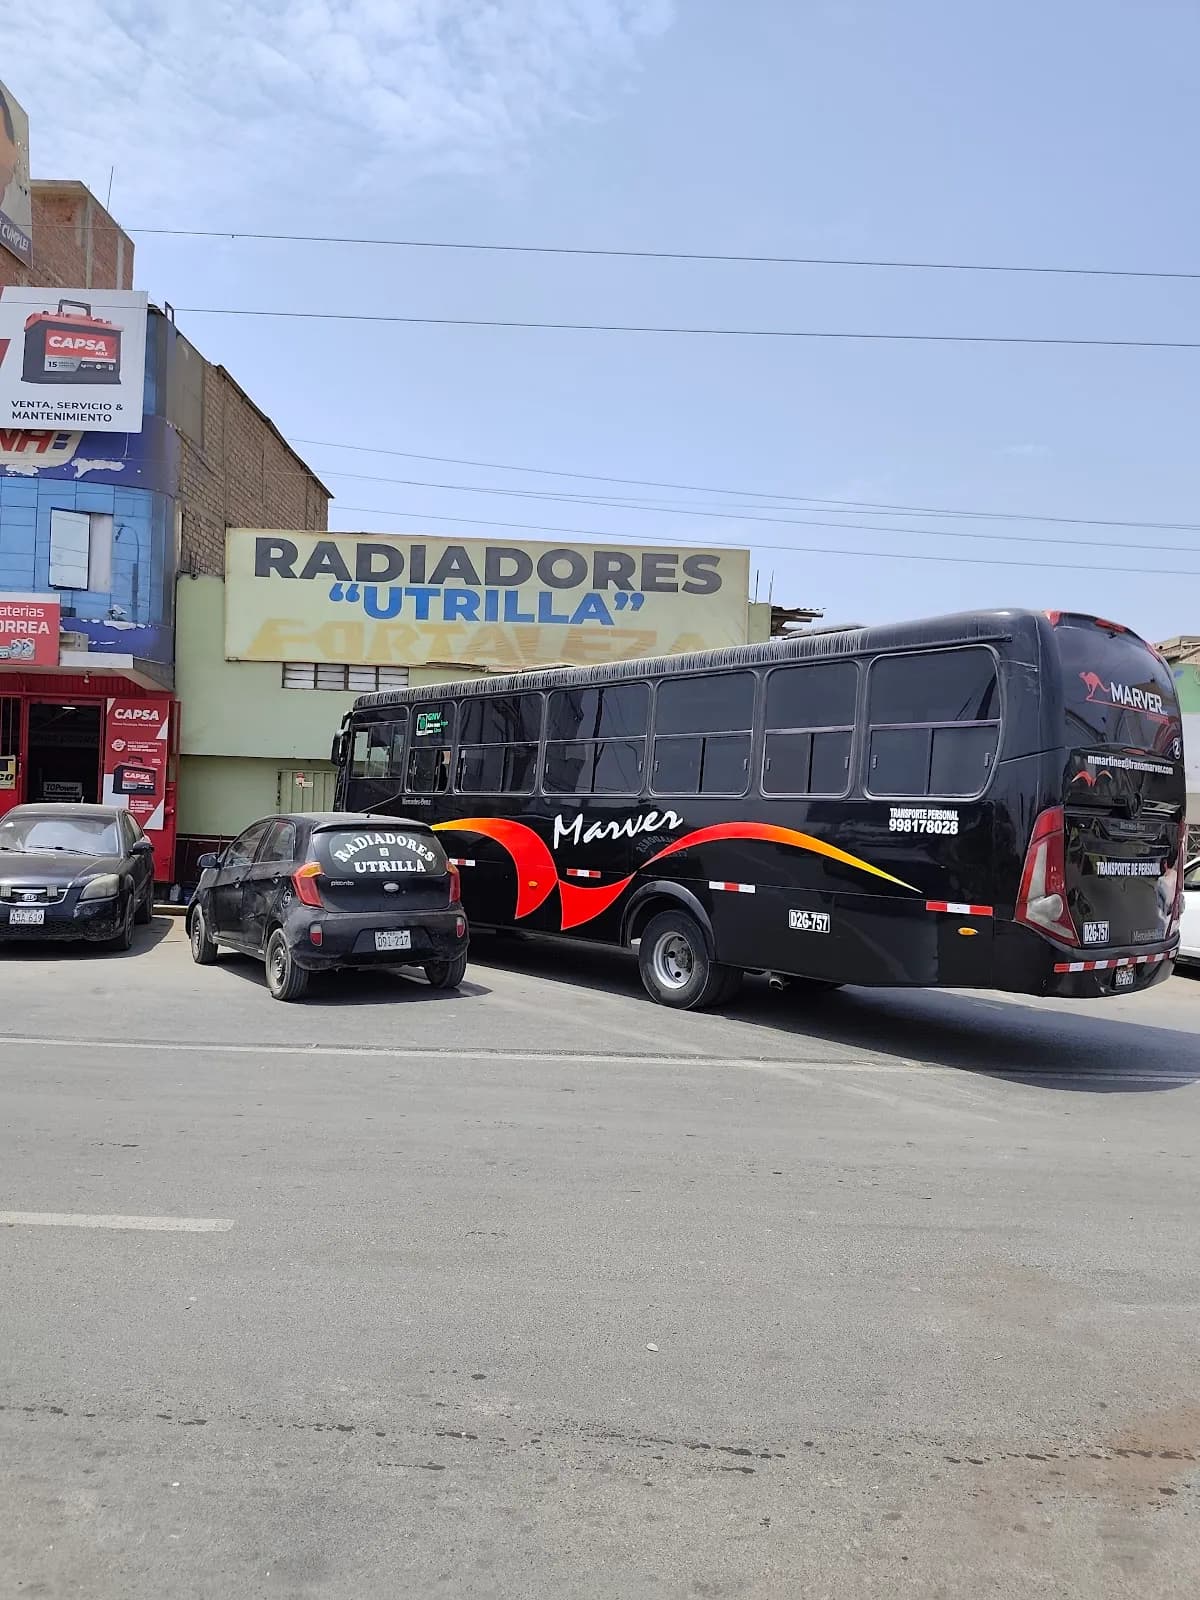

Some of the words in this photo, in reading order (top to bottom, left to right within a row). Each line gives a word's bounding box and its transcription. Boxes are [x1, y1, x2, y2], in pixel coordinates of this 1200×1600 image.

[48, 335, 107, 351] CAPSA
[11, 400, 54, 410] VENTA,
[57, 401, 112, 411] SERVICIO
[115, 403, 124, 411] &
[11, 411, 113, 423] MANTENIMIENTO
[255, 537, 723, 595] RADIADORES
[1110, 681, 1163, 714] MARVER
[114, 708, 160, 721] CAPSA
[124, 772, 150, 780] CAPSA
[889, 807, 928, 820] TRANSPORTE
[927, 809, 960, 821] PERSONAL
[553, 810, 684, 850] Marver
[889, 818, 959, 835] 998178028
[334, 833, 436, 863] RADIADORES
[354, 859, 427, 873] UTRILLA
[1096, 861, 1131, 876] TRANSPORTE
[1131, 862, 1138, 876] DE
[790, 911, 828, 931] D2G-757
[1084, 923, 1108, 942] D2G-757
